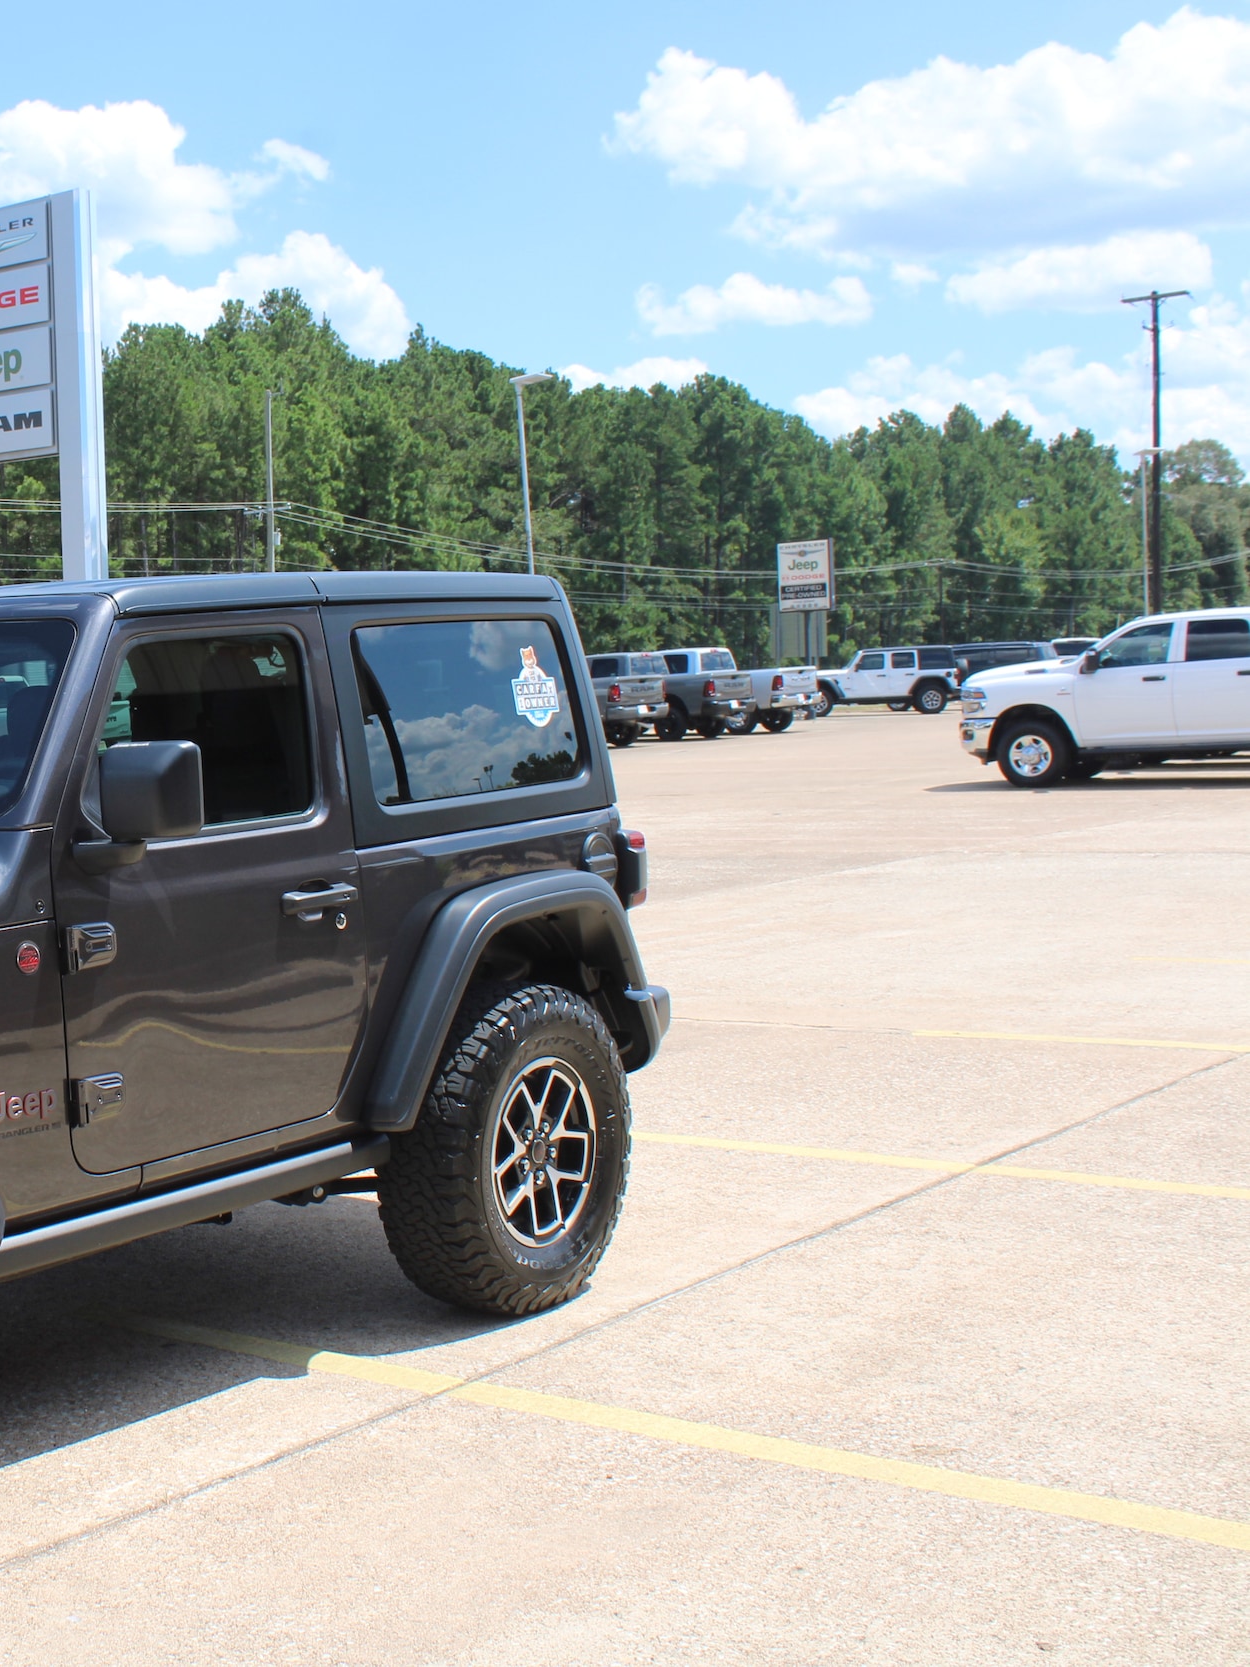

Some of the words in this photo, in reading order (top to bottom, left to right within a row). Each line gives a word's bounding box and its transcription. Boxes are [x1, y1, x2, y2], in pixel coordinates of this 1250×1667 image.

[788, 559, 818, 571] Jeep
[791, 573, 825, 581] DODGE
[785, 584, 822, 593] CERTIFIED
[781, 591, 826, 600] PRE-OWNED
